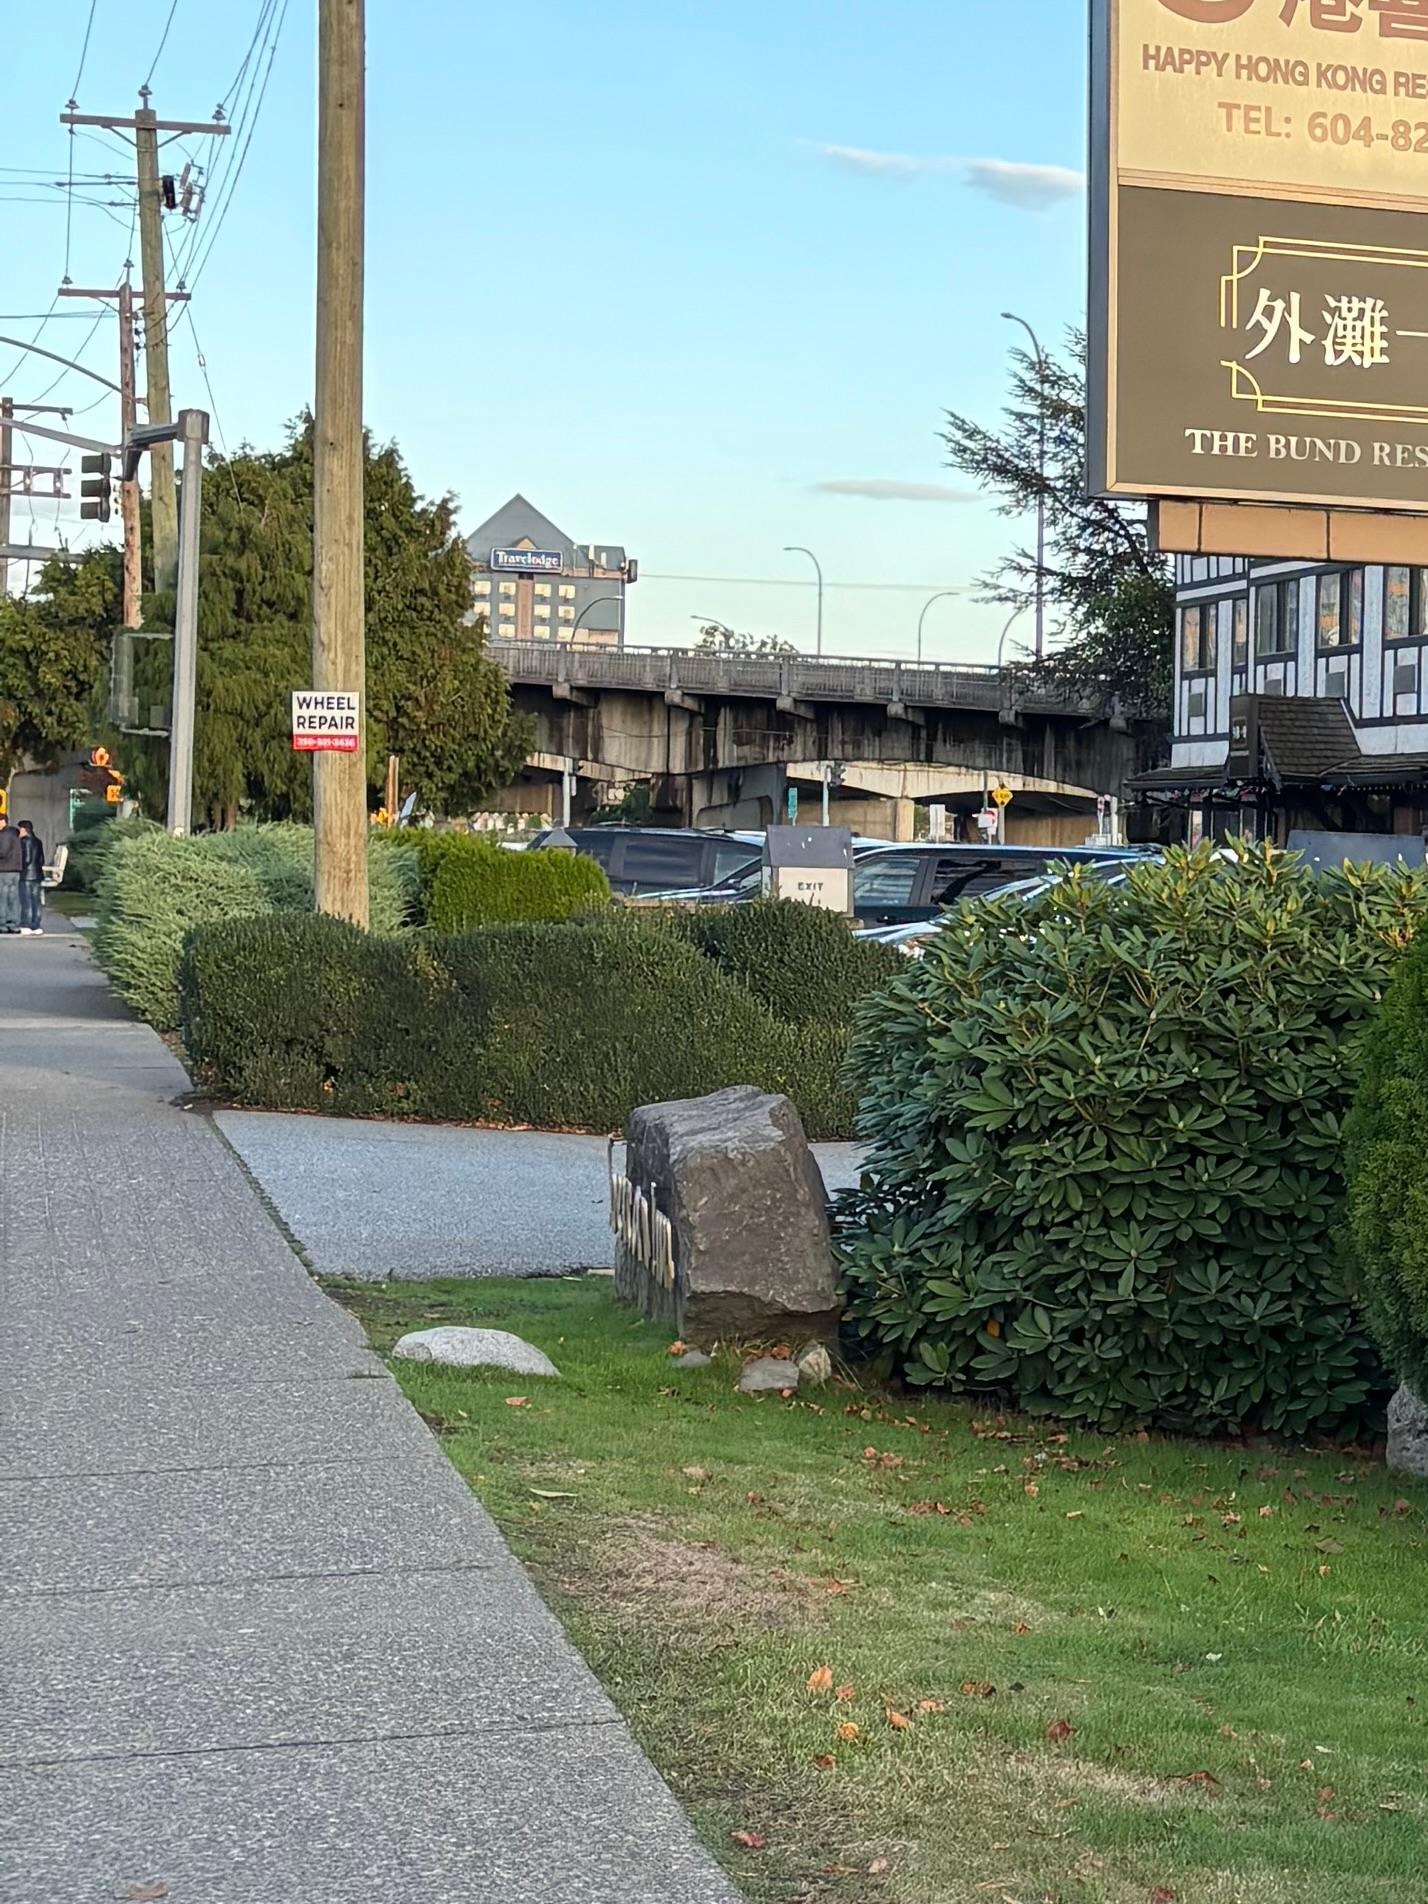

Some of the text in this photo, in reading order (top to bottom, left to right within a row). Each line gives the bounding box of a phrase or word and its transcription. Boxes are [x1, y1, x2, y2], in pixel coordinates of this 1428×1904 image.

[1142, 44, 1231, 78] HAPPY
[1235, 56, 1310, 87] HONG
[1316, 64, 1387, 96] KONG
[1218, 101, 1292, 140] TEL:
[1184, 428, 1258, 459] THE
[1268, 435, 1362, 465] BUND
[496, 551, 559, 569] Travelodge
[297, 696, 356, 710] WHEEL
[297, 715, 355, 729] REPAIR
[798, 882, 823, 891] EXIT
